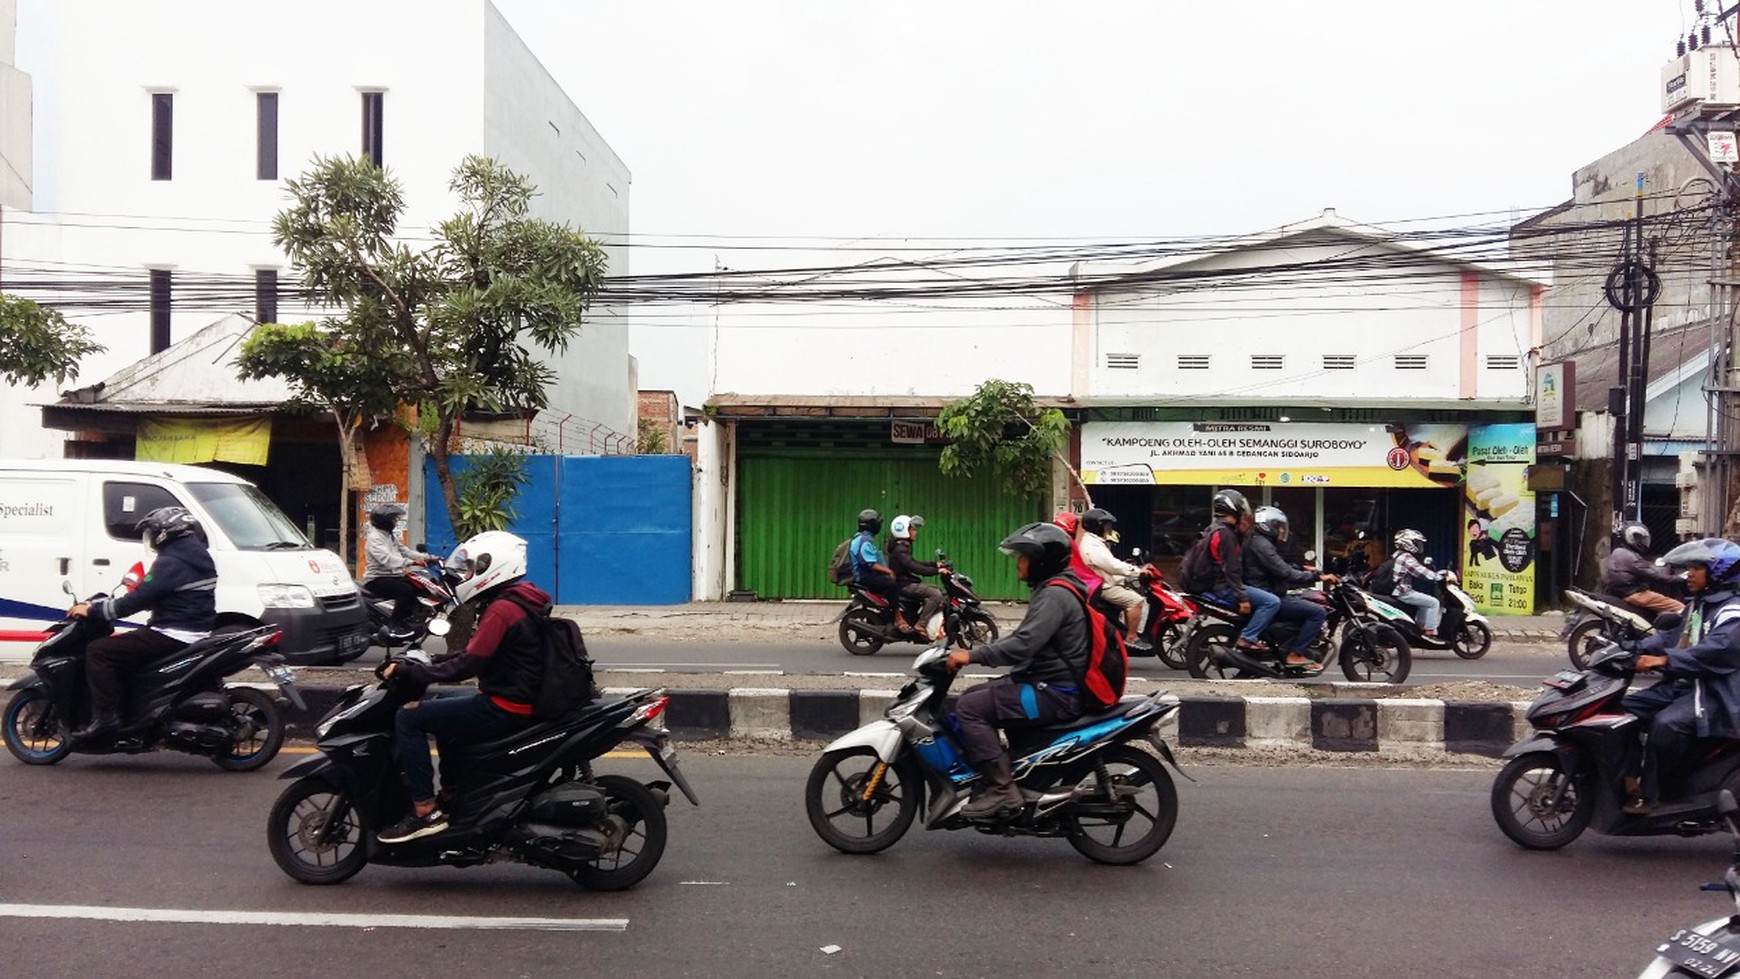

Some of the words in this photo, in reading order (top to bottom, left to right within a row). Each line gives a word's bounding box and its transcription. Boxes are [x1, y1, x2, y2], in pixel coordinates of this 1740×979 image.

[893, 424, 924, 439] SEWA
[1173, 438, 1236, 449] OLEH-OLEH
[1239, 438, 1298, 449] SEMANGGI
[1236, 450, 1279, 458] GEDANGAN
[1281, 451, 1319, 459] SIDOARJO
[1670, 929, 1687, 942] S
[1681, 934, 1719, 954] 5159
